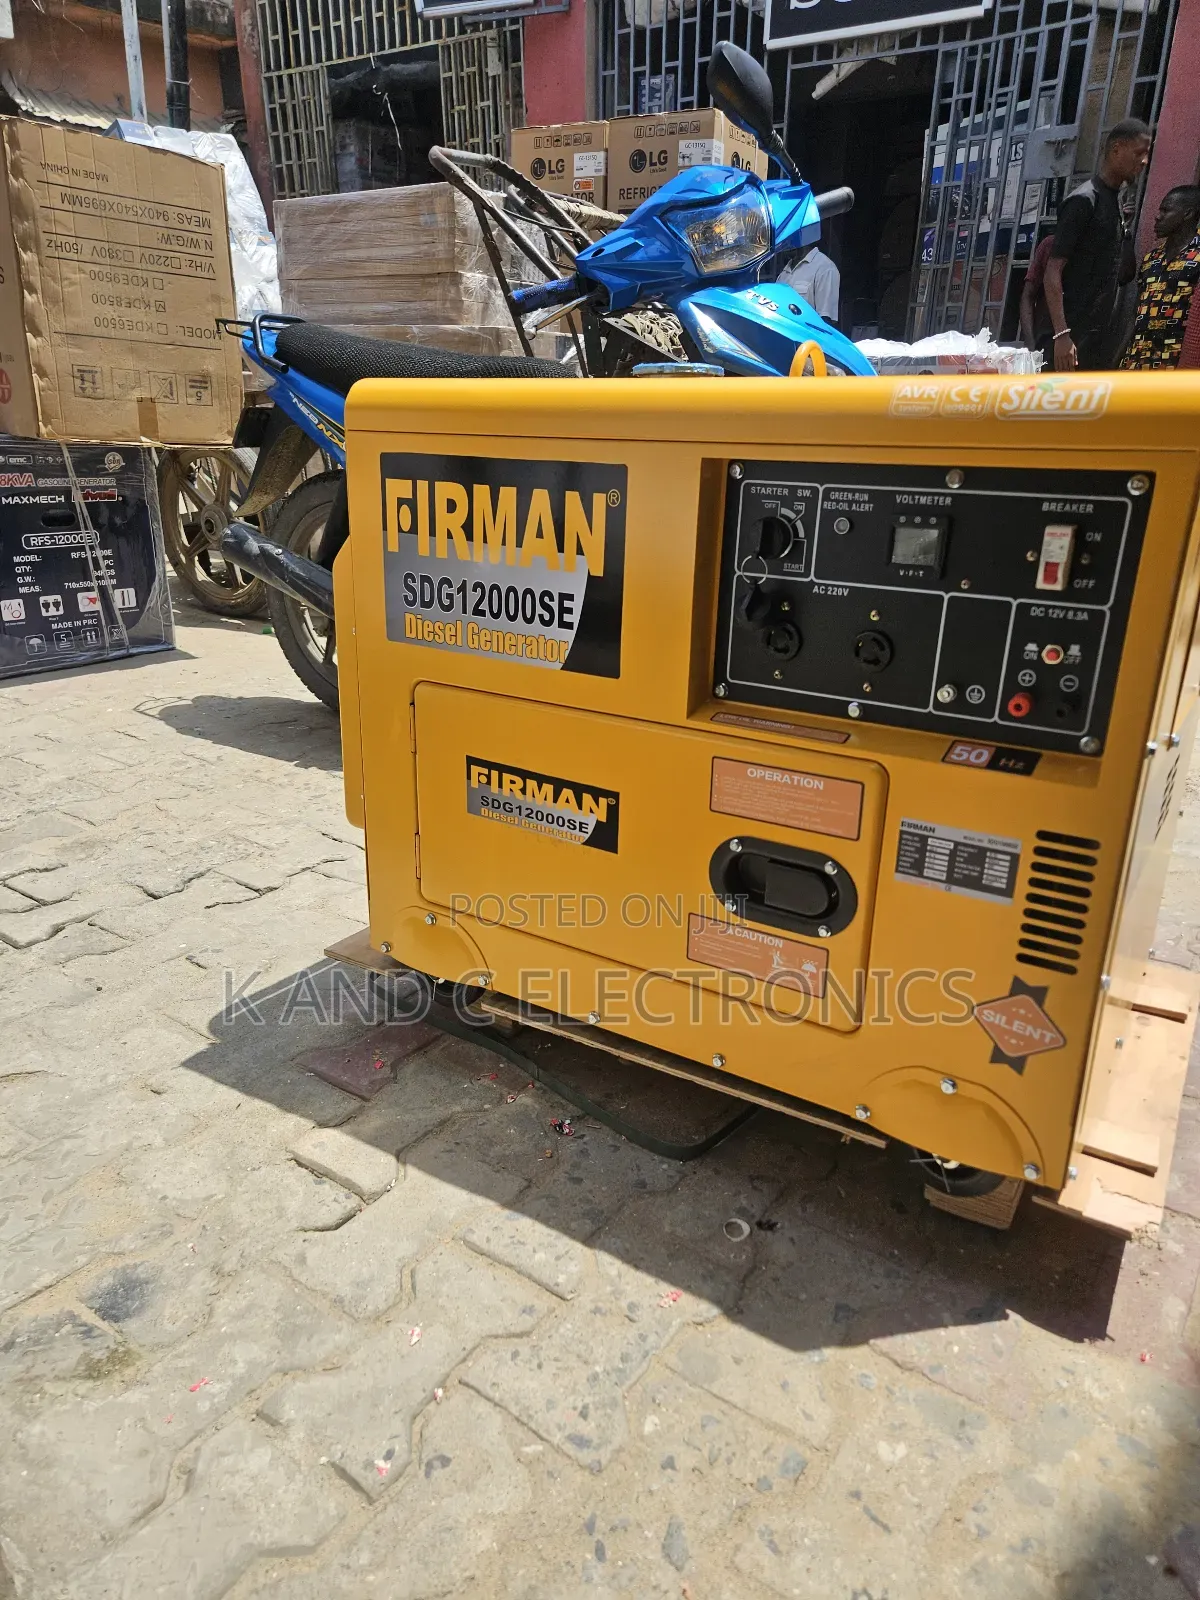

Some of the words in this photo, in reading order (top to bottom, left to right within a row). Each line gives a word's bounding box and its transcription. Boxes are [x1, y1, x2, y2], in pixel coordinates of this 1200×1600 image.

[649, 150, 668, 167] LG
[40, 161, 70, 176] CHINA
[71, 168, 82, 178] IN
[548, 159, 565, 175] LG
[82, 169, 109, 183] MADE
[172, 212, 211, 229] MEAS:
[91, 244, 122, 261] 380V
[139, 252, 170, 267] 220V
[184, 258, 216, 274] V/Hz:
[89, 269, 149, 287] KDE9500
[91, 293, 151, 310] KDE8500
[745, 289, 779, 312] TVS
[93, 316, 154, 333] KDE6500
[175, 325, 222, 340] MODEL:
[899, 386, 937, 398] AVR
[1002, 384, 1108, 411] Silent
[37, 478, 74, 487] GASOLIN
[750, 486, 789, 496] STARTER
[797, 489, 812, 497] SW.
[829, 491, 869, 501] GREEN-RUN
[2, 495, 65, 505] MAXMECH
[823, 501, 850, 511] RED-OIL
[851, 503, 874, 512] ALERT
[896, 494, 953, 506] VOLTMETER
[1042, 502, 1094, 514] BREAKER
[386, 478, 606, 577] FIRMAN
[1085, 532, 1103, 542] ON
[13, 555, 42, 563] MODEL:
[19, 586, 42, 594] MEAS:
[813, 585, 826, 594] AC
[827, 587, 850, 597] 220V
[1073, 579, 1096, 589] OFF
[402, 571, 575, 630] SDG12000SE
[1030, 606, 1046, 617] DC
[1048, 608, 1066, 619] 12V
[51, 621, 73, 630] MADE
[83, 618, 98, 626] PRC
[404, 612, 462, 646] Diesel
[467, 622, 569, 664] Generator
[951, 745, 989, 764] 50
[747, 767, 824, 790] OPERATION
[470, 764, 608, 823] FIRMAN
[480, 795, 589, 834] SDG12000SE
[480, 807, 519, 825] Diesel
[521, 816, 585, 843] Generator
[735, 927, 784, 948] CAUTION
[982, 1009, 1057, 1045] SILENT
